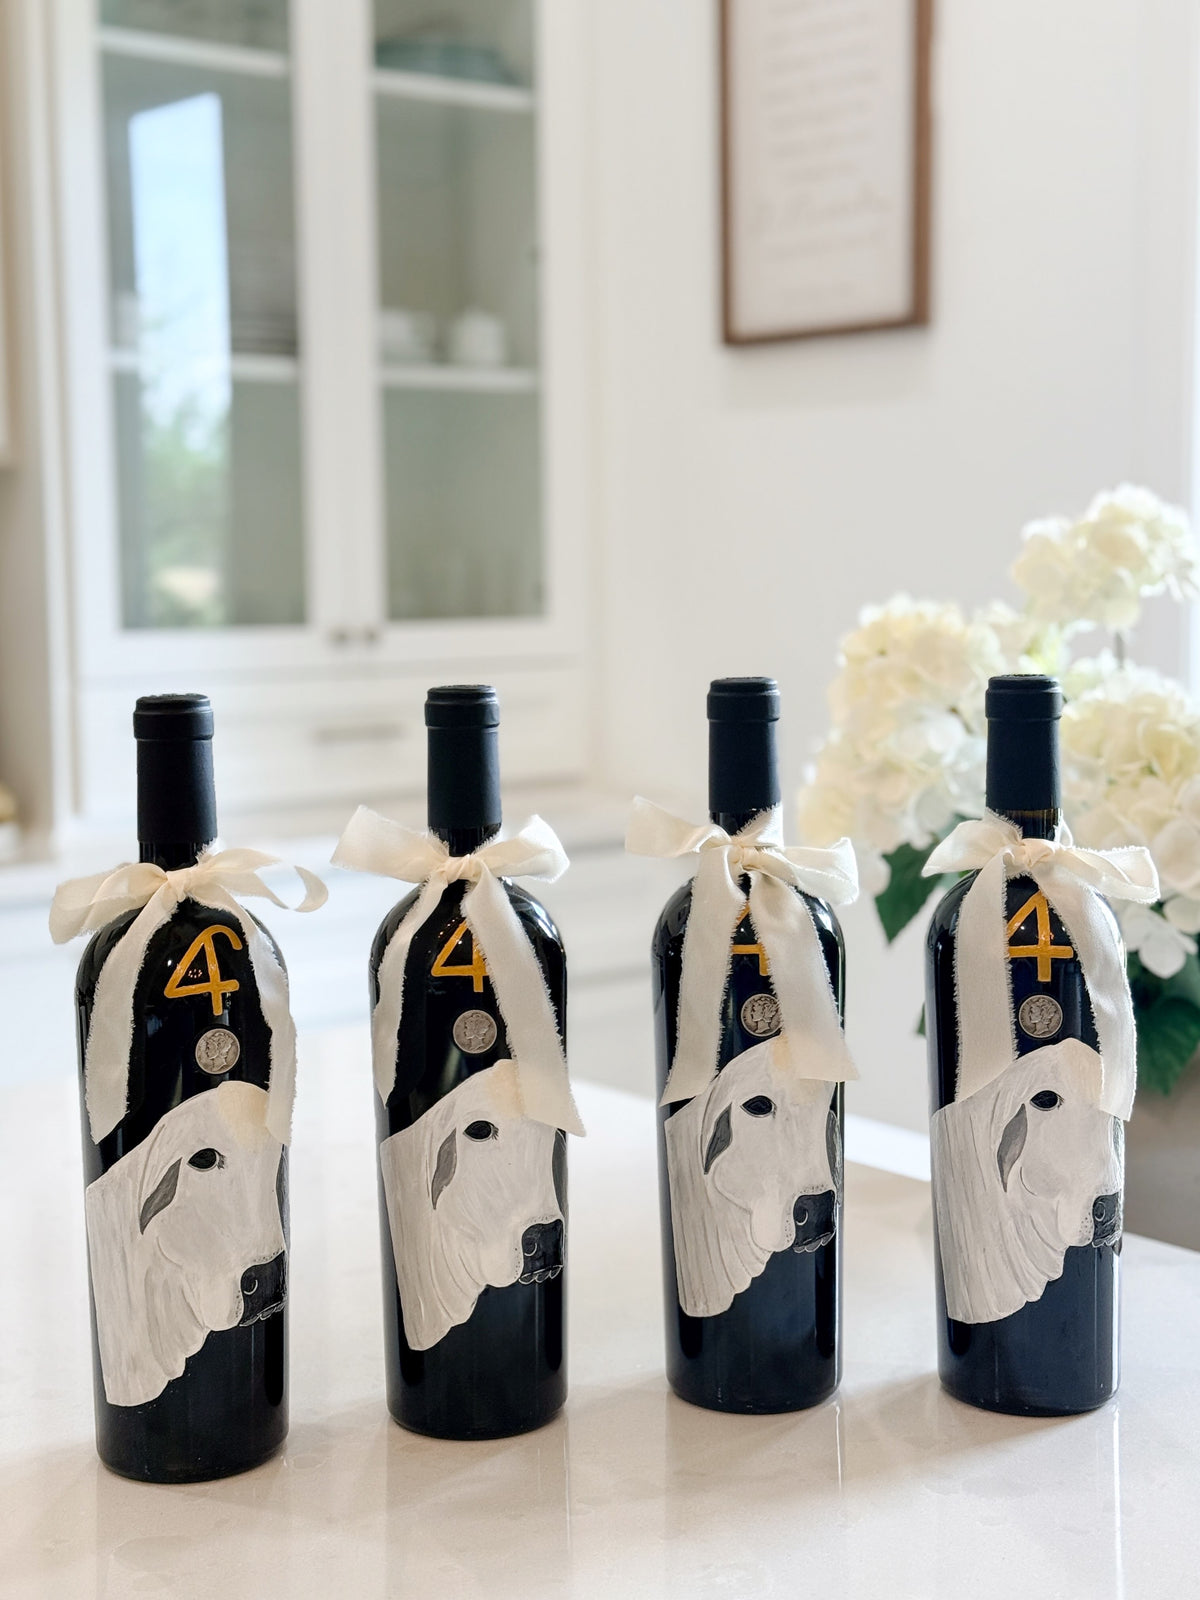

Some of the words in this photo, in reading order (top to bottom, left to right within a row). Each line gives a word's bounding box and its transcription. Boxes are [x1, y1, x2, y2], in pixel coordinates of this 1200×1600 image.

[164, 924, 242, 1016] 4
[431, 919, 490, 992] 4
[1007, 890, 1074, 982] 4
